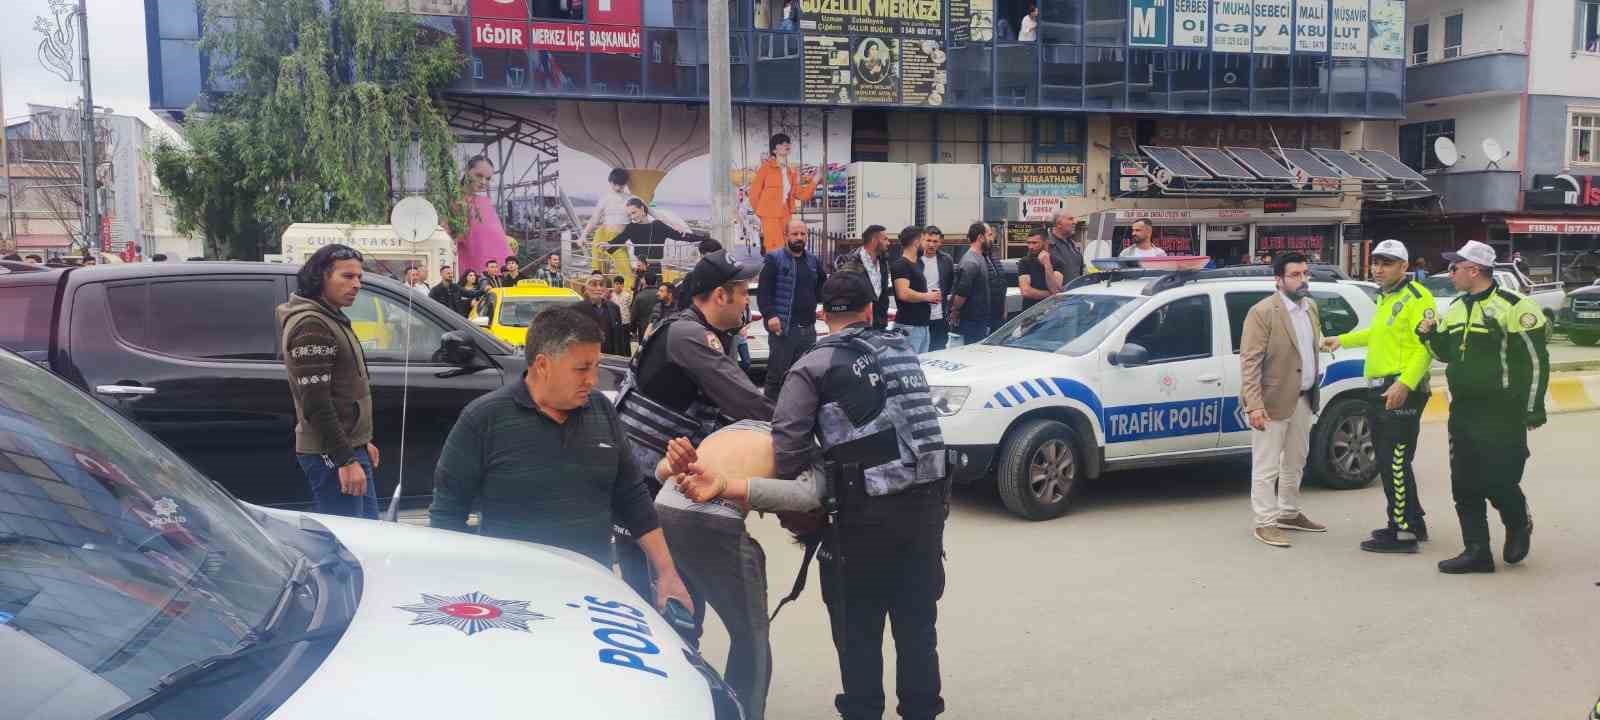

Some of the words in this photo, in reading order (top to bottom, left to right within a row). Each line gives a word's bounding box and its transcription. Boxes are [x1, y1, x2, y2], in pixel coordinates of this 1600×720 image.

[476, 24, 522, 45] IĞDIR
[532, 29, 566, 46] MERKEZ
[567, 27, 585, 51] İLÇE
[589, 29, 641, 51] BAŞKANLIĞI
[1012, 165, 1035, 174] KOZA
[1037, 165, 1057, 174] GIDA
[1059, 165, 1081, 174] CAFE
[1023, 175, 1078, 184] KIRAATHANE
[1109, 406, 1165, 436] TRAFİK
[1168, 400, 1219, 428] POLİSİ
[565, 595, 669, 678] POLİS
